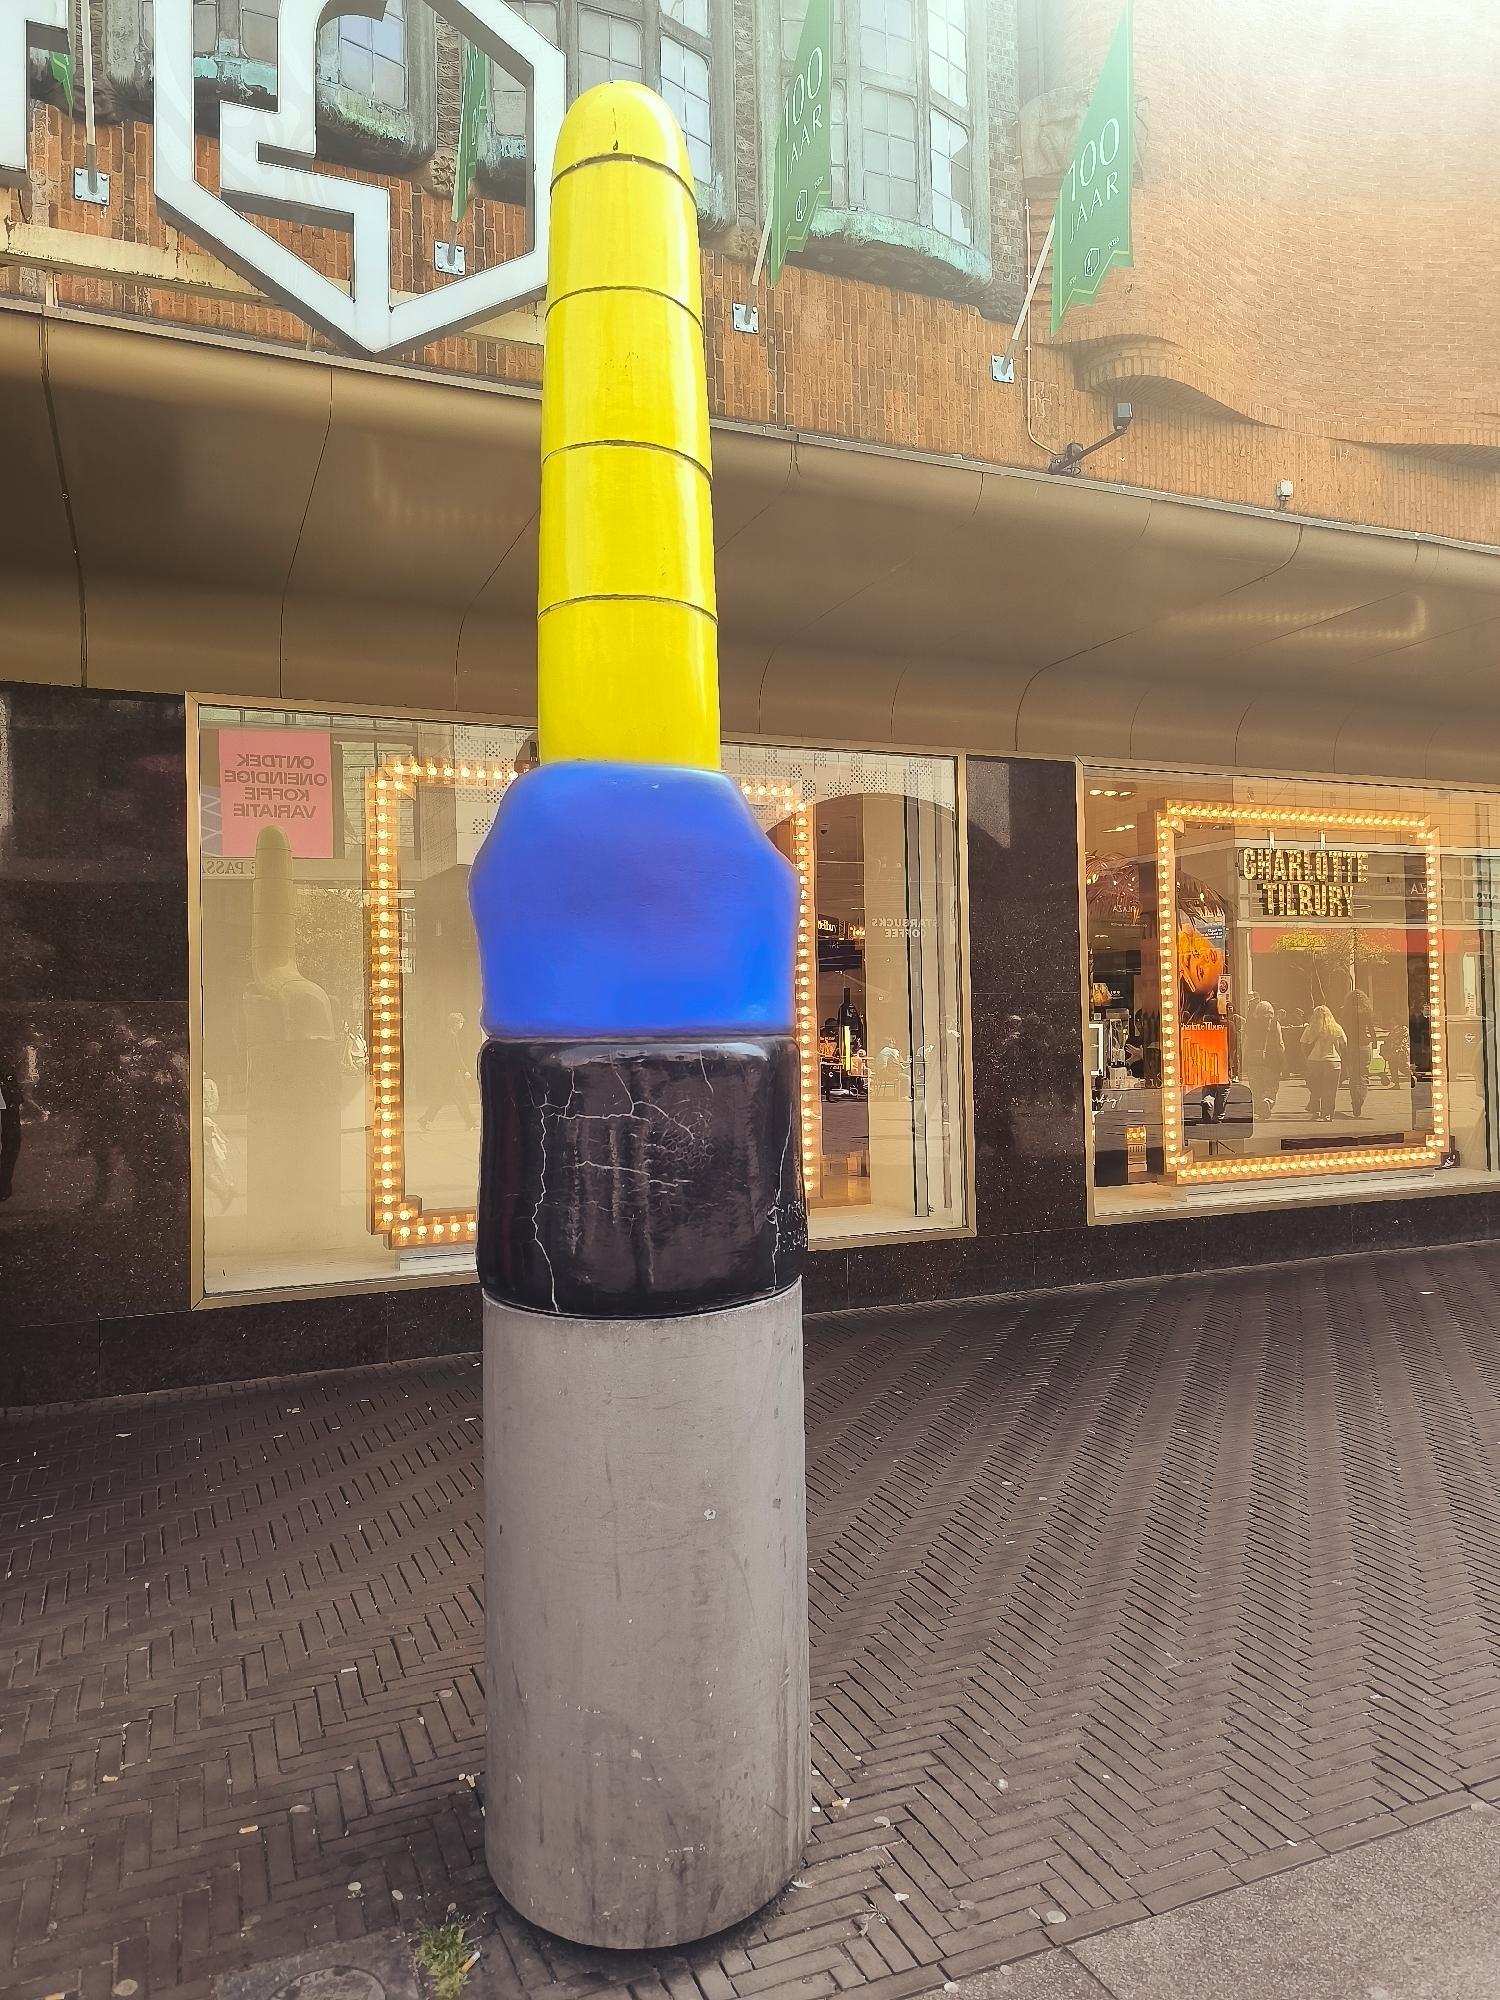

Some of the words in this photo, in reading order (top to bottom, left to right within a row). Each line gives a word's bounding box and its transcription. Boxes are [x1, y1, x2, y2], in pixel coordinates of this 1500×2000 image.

[784, 46, 823, 143] 100
[785, 103, 823, 188] JAAR
[1067, 117, 1120, 202] 100
[1069, 171, 1120, 244] JAAR
[1242, 847, 1368, 883] CHARLOTTE
[1260, 882, 1354, 918] TILBURY
